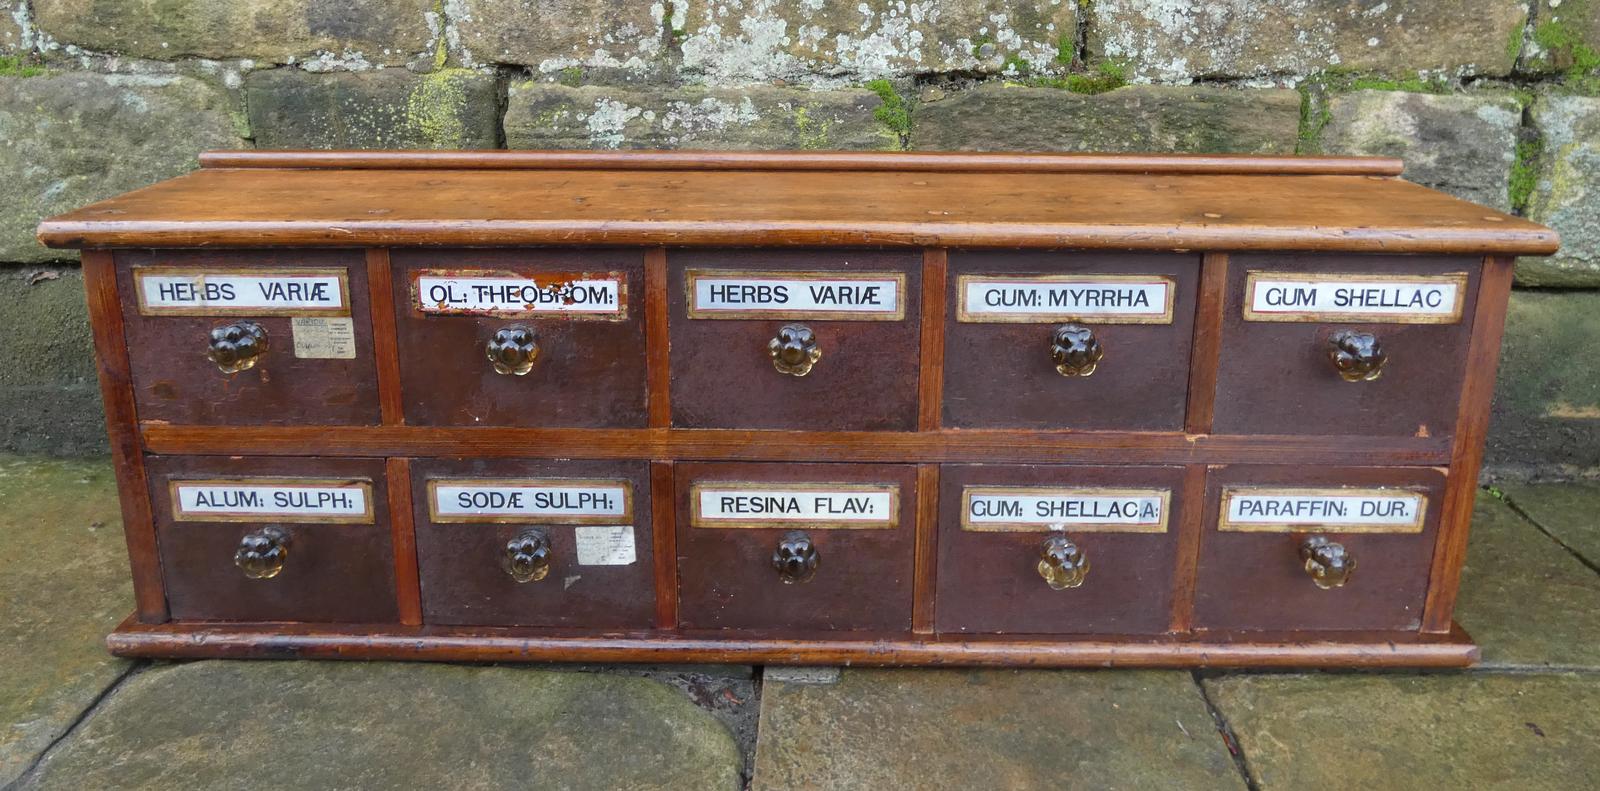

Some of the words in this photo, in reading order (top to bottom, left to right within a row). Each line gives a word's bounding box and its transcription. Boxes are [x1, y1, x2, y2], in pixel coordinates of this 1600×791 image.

[159, 282, 236, 301] HERBS
[258, 282, 331, 301] VARIÆ
[429, 285, 468, 304] OL:
[709, 284, 789, 304] HERBS
[808, 285, 882, 305] VARIÆ
[984, 288, 1042, 308] GUM:
[1047, 289, 1150, 308] MYRRHA
[1265, 287, 1317, 307] GUM
[1333, 288, 1443, 309] SHELLAC
[195, 490, 265, 508] ALUM:
[273, 491, 353, 509] SULPH:
[458, 491, 524, 509] SODÆ
[534, 492, 614, 510] SULPH:
[720, 496, 801, 514] RESINA
[814, 497, 875, 515] FLAV:
[970, 499, 1024, 518] GUM:
[1238, 500, 1348, 517] PARAFFIN:
[1359, 500, 1410, 518] DUR.
